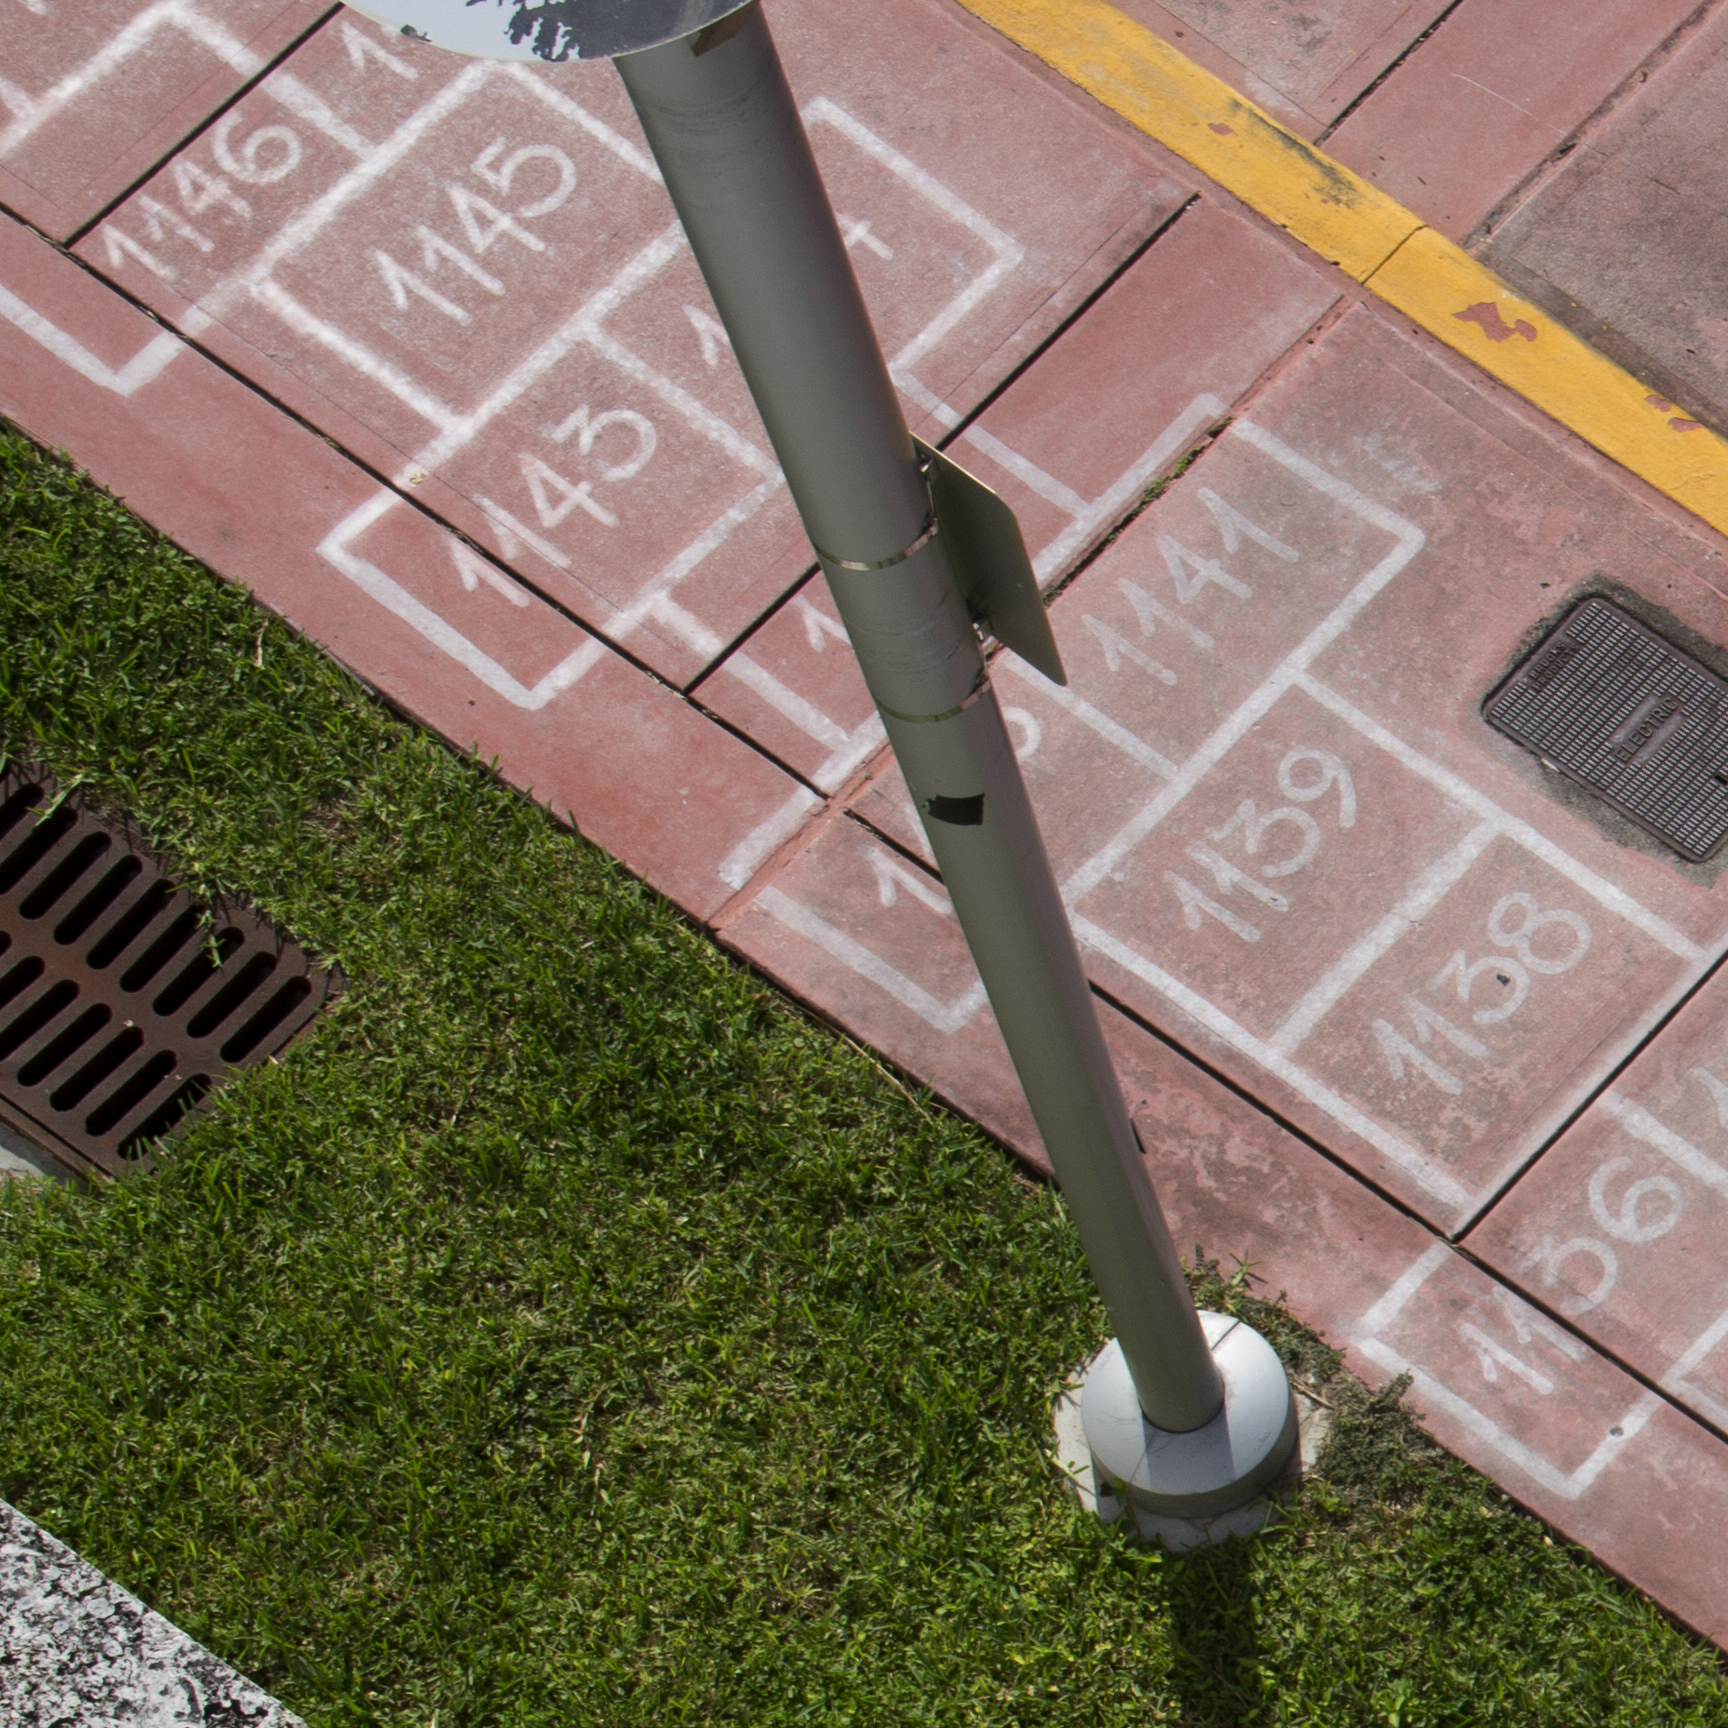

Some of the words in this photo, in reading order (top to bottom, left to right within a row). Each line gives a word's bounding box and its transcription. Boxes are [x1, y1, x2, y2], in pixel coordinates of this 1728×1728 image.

[102, 111, 301, 281] 1146
[371, 138, 577, 326] 1145
[446, 404, 657, 606] 1143
[1082, 487, 1300, 685] 1141
[1529, 641, 1567, 680] BROOKS
[1614, 697, 1679, 763] ELECTRIC
[1164, 748, 1356, 943] 1139
[1372, 893, 1591, 1094] 1138
[1462, 1157, 1683, 1393] 1136
